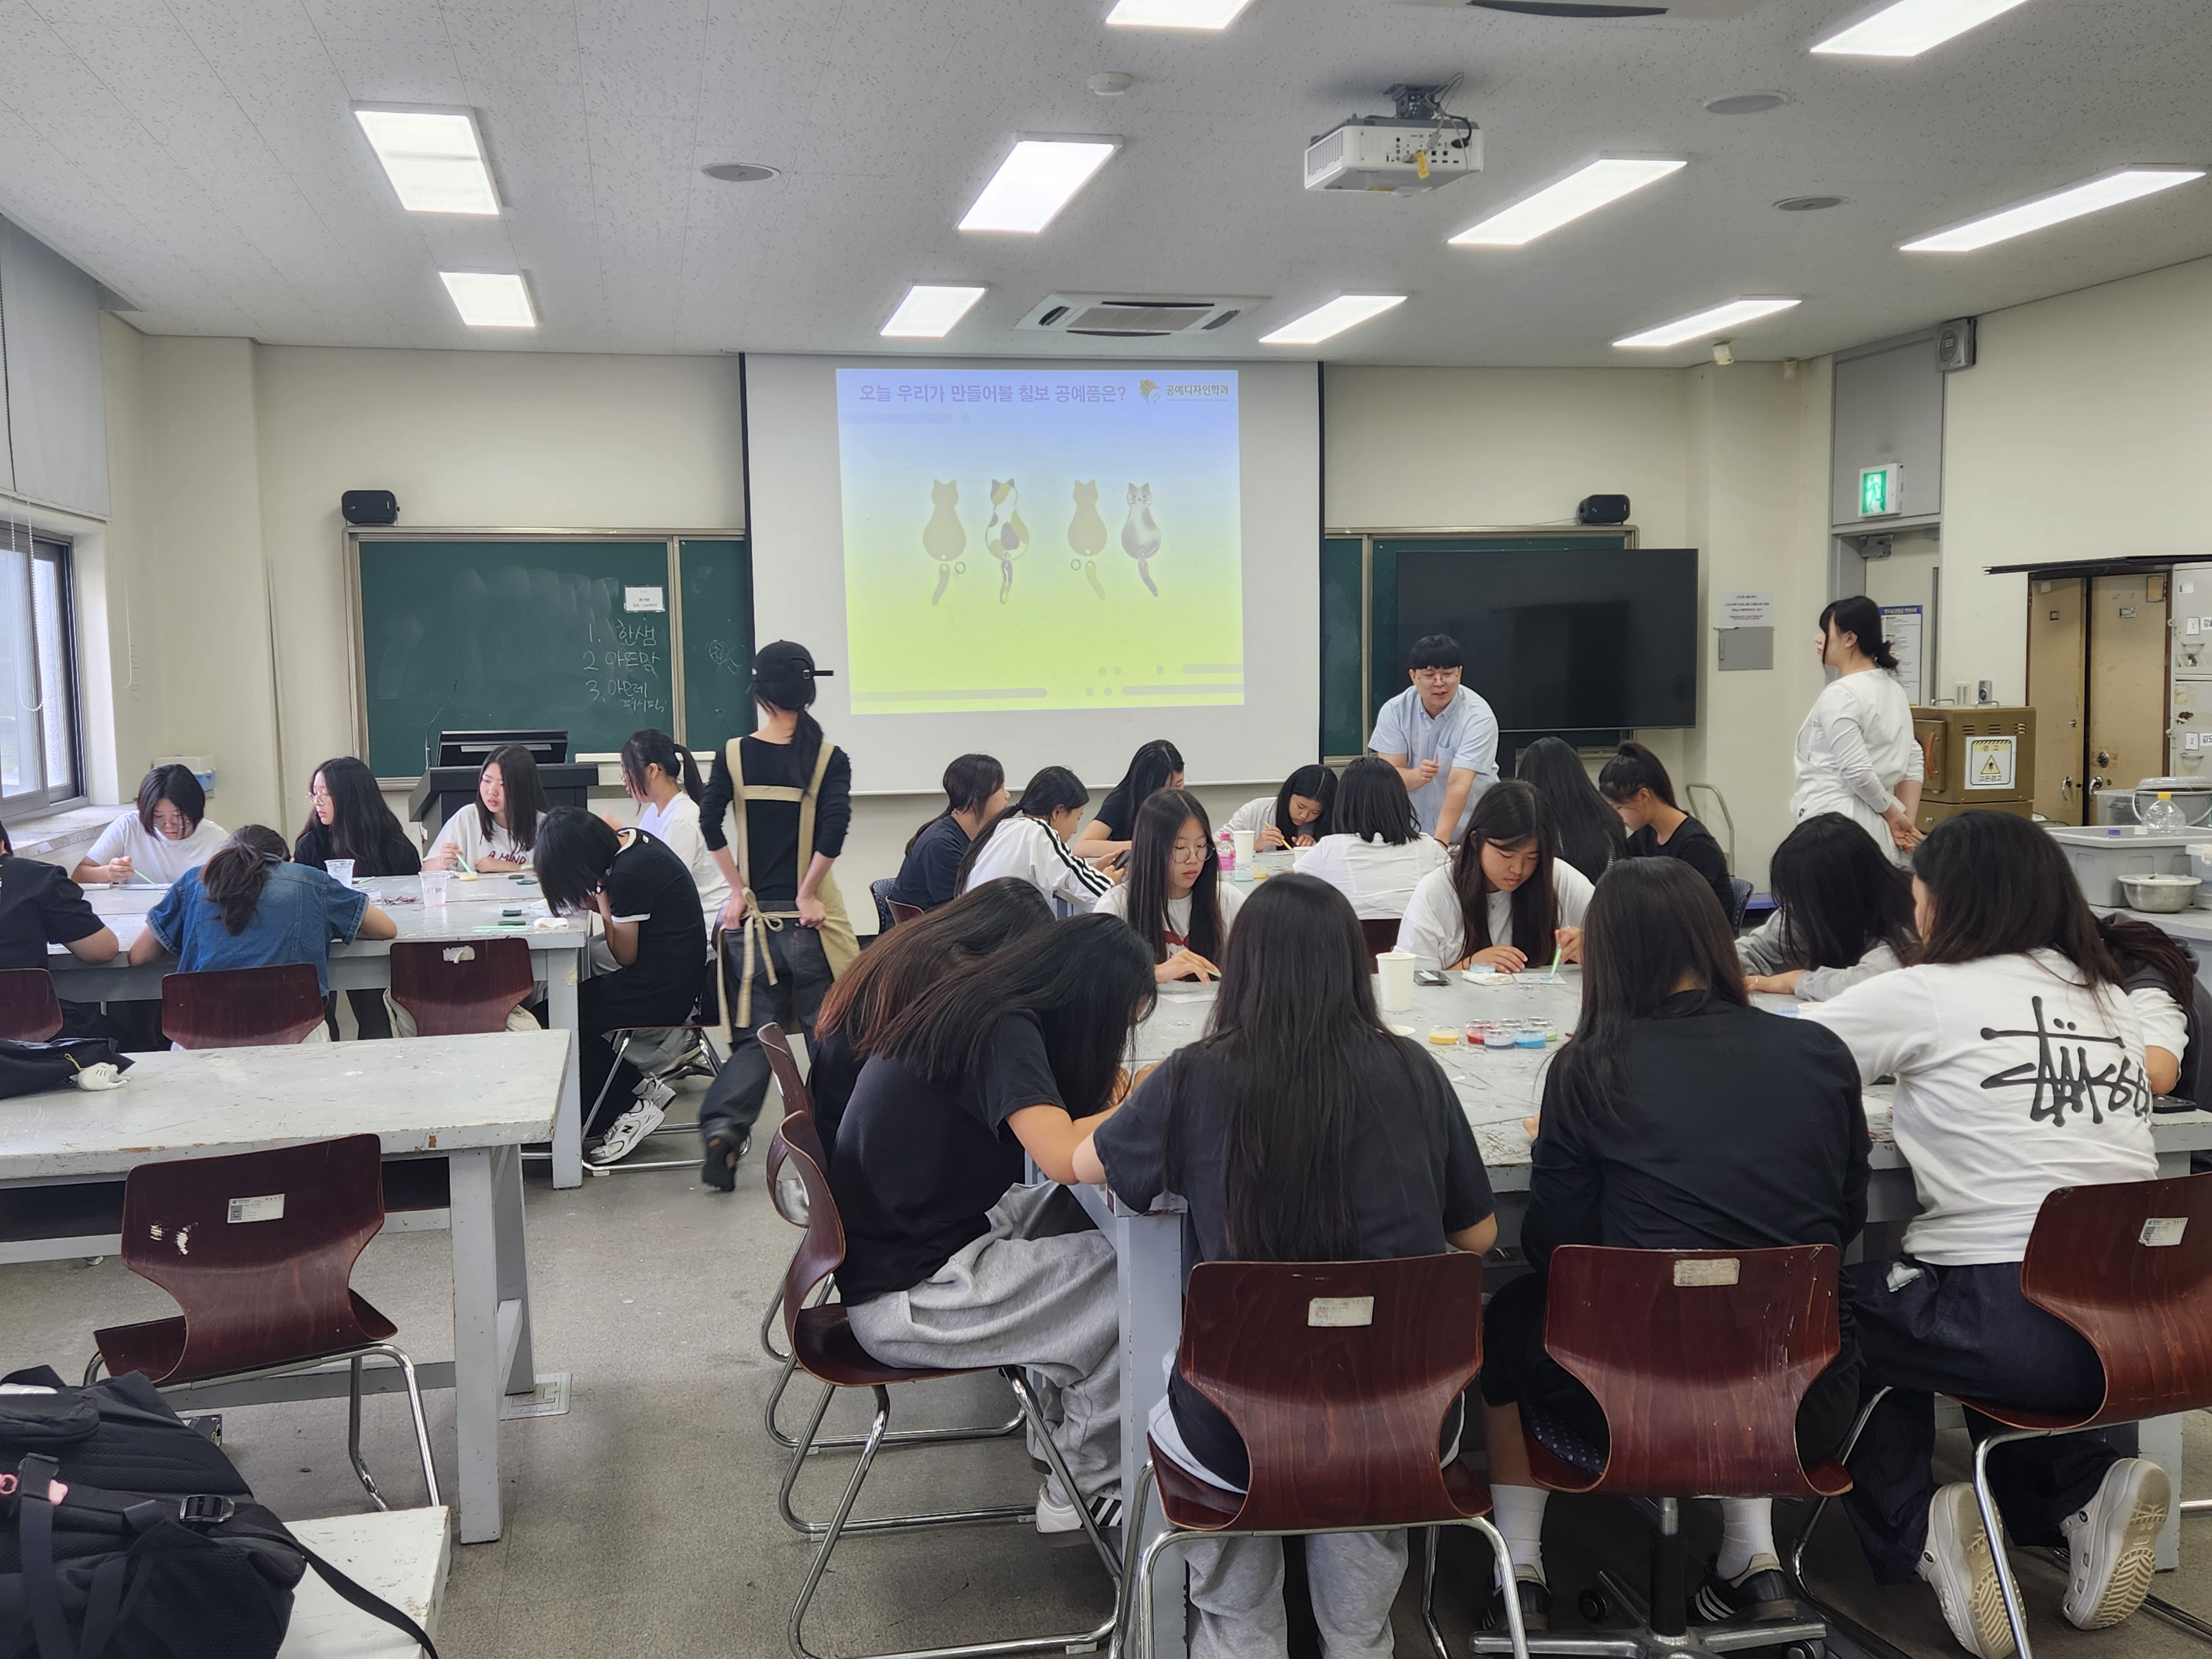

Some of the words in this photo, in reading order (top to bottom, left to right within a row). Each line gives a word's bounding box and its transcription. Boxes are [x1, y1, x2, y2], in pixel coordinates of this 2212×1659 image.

[859, 385, 891, 402] 오늘
[897, 385, 945, 403] 우리가
[951, 385, 1014, 403] 만들어볼
[1019, 385, 1050, 403] 칠보
[1055, 385, 1126, 403] 공예품은?
[1166, 385, 1229, 395] 공예디자인학과
[589, 623, 601, 643] 1.
[615, 619, 656, 646] 한샘
[499, 852, 526, 865] MIND
